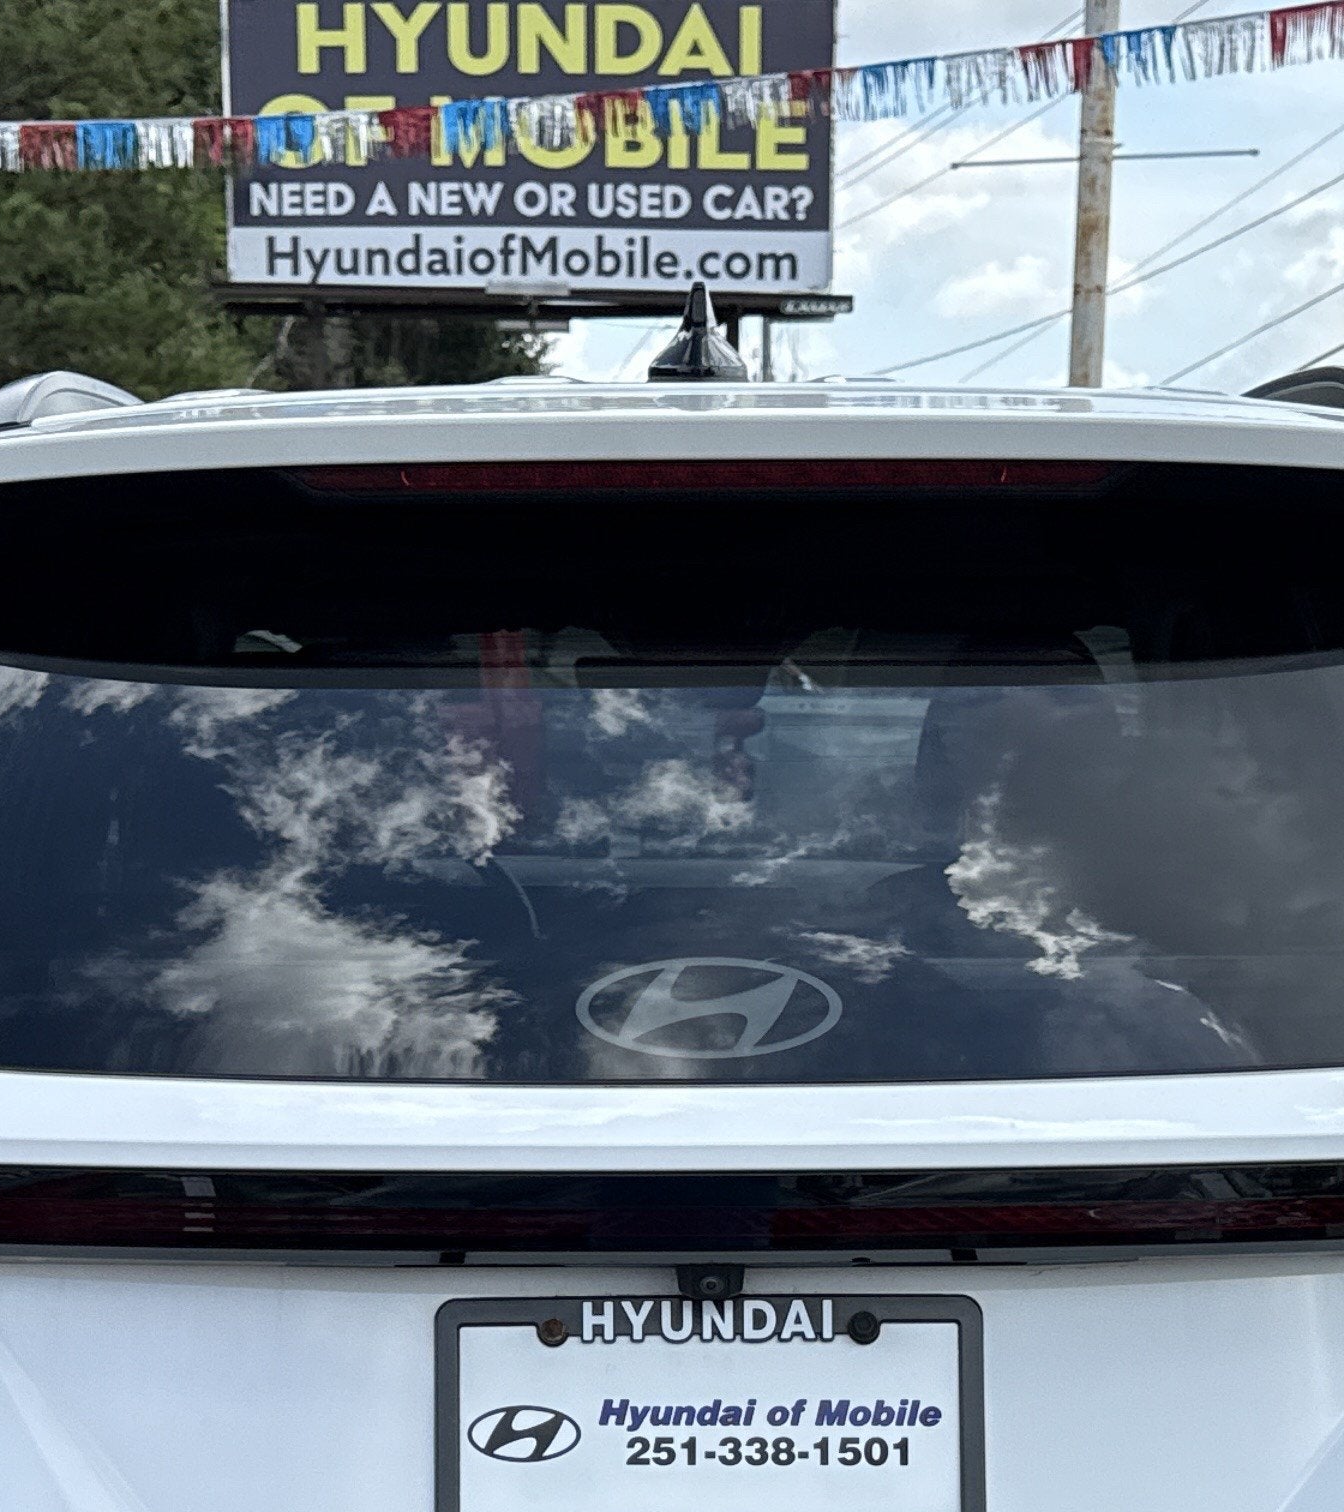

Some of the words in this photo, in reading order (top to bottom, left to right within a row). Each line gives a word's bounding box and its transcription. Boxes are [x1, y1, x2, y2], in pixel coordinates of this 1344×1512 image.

[296, 2, 762, 76] HYUNDAI
[249, 182, 356, 216] NEED
[365, 181, 398, 216] A
[408, 182, 504, 216] NEW
[513, 181, 576, 217] OR
[587, 183, 692, 219] USED
[702, 184, 814, 221] CAR?
[266, 233, 799, 284] HyundaiofMobile.com
[581, 1300, 834, 1342] HYUNDAI
[599, 1399, 754, 1433] Hyundai
[767, 1399, 808, 1428] of
[816, 1400, 942, 1428] Mobile
[626, 1436, 910, 1467] 251-338-1501
